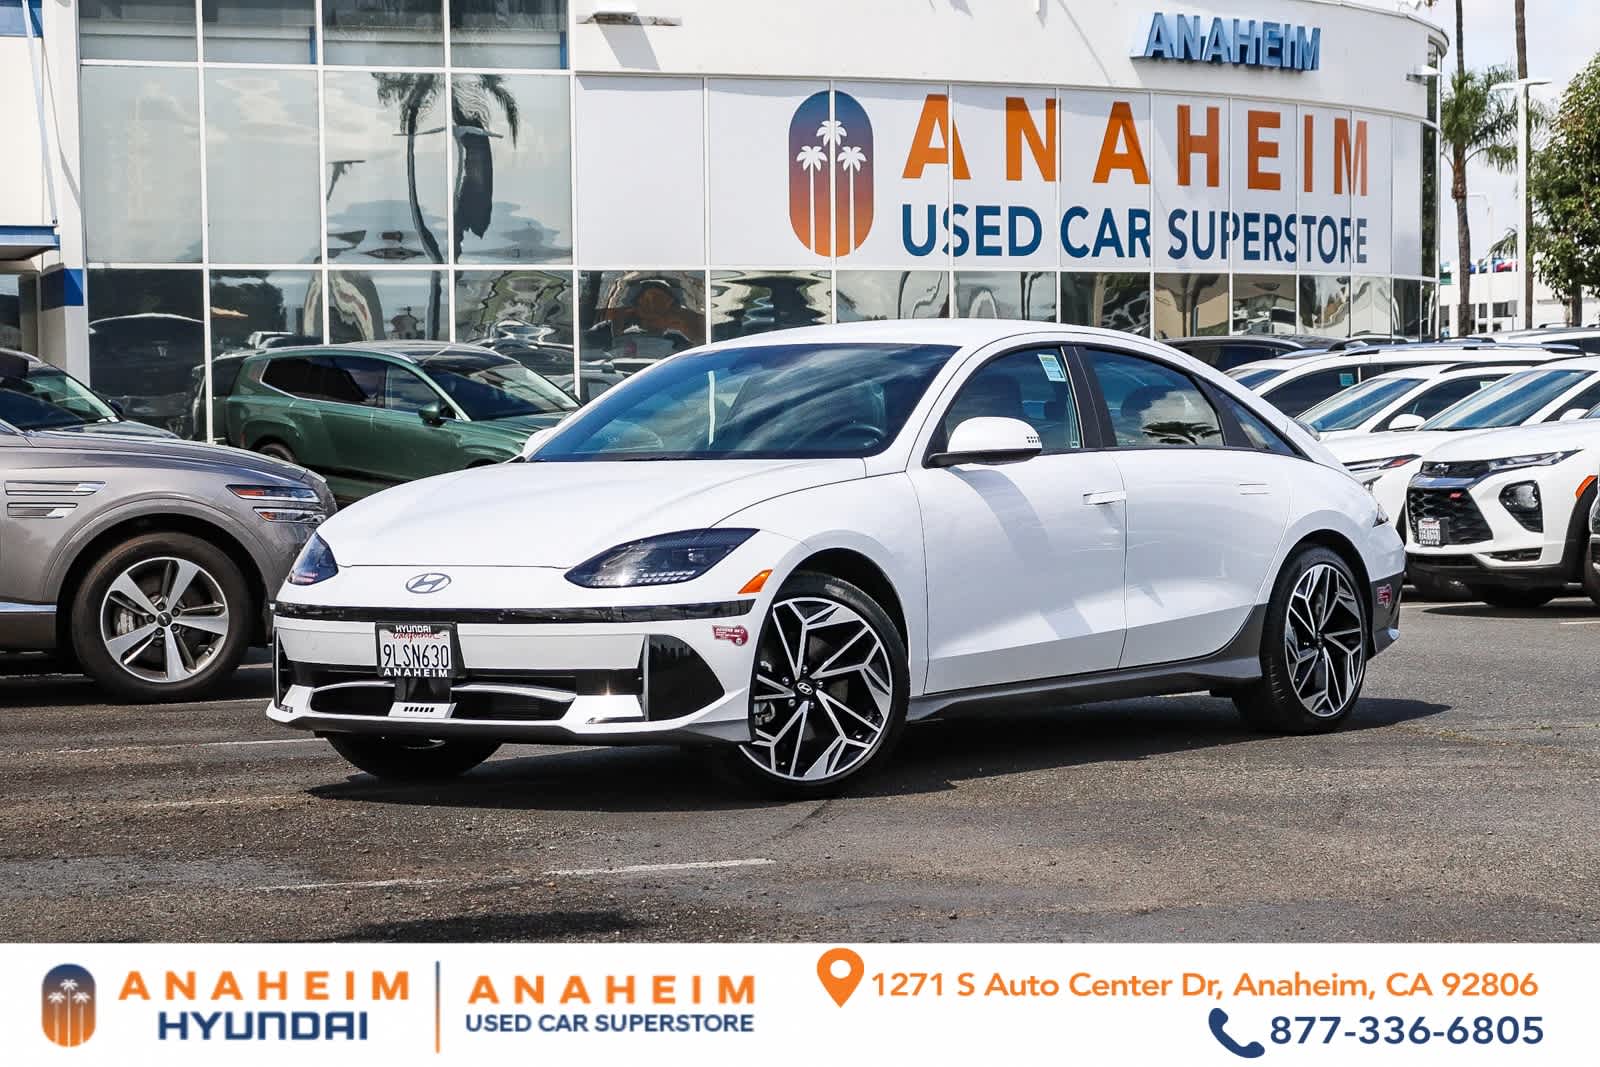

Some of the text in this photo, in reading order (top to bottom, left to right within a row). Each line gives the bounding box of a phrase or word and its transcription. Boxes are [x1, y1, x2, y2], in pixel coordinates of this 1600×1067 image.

[1144, 12, 1321, 71] ANAHEIM
[902, 93, 1368, 197] ANAHEIM
[902, 203, 1367, 264] USED CAR SUPERSTORE
[395, 624, 431, 633] HYUNDAI
[383, 643, 449, 668] 9LSN630
[383, 667, 448, 678] ANAHEIM
